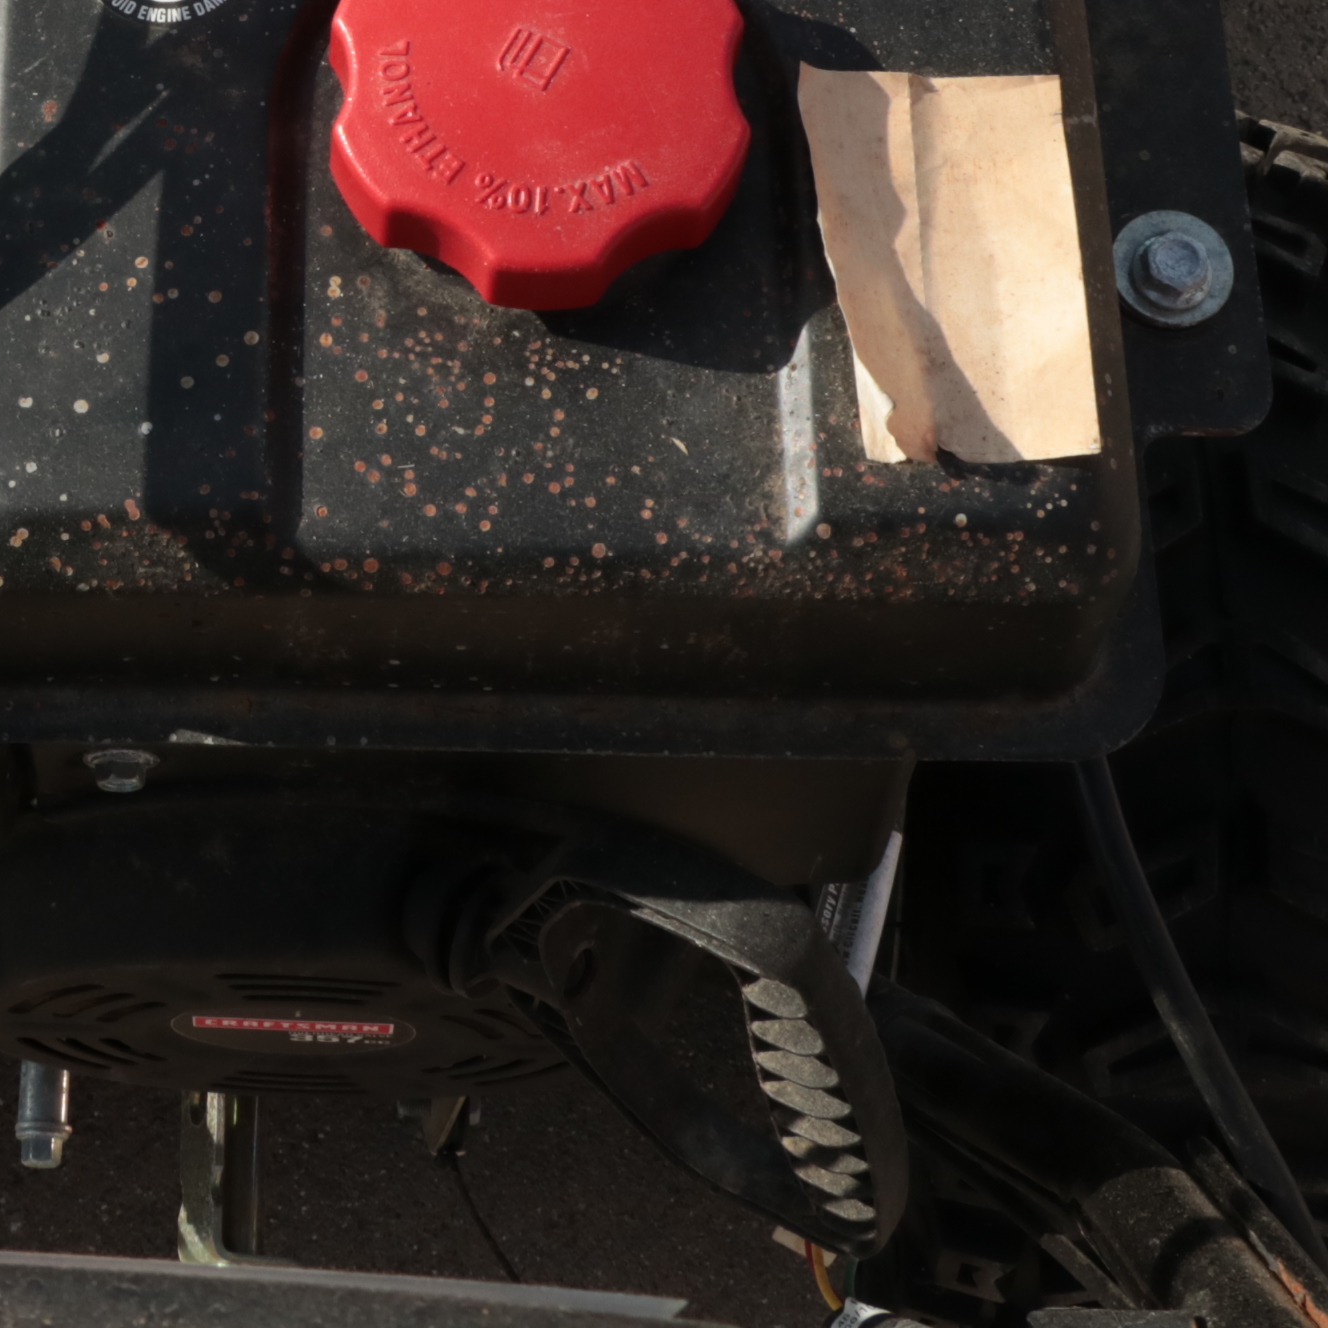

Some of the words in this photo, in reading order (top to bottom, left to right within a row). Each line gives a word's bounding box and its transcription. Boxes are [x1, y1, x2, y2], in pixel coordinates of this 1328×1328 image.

[138, 6, 191, 23] ENGINE
[379, 39, 466, 186] ETHANOL
[204, 1019, 379, 1031] CRAFTSMAN
